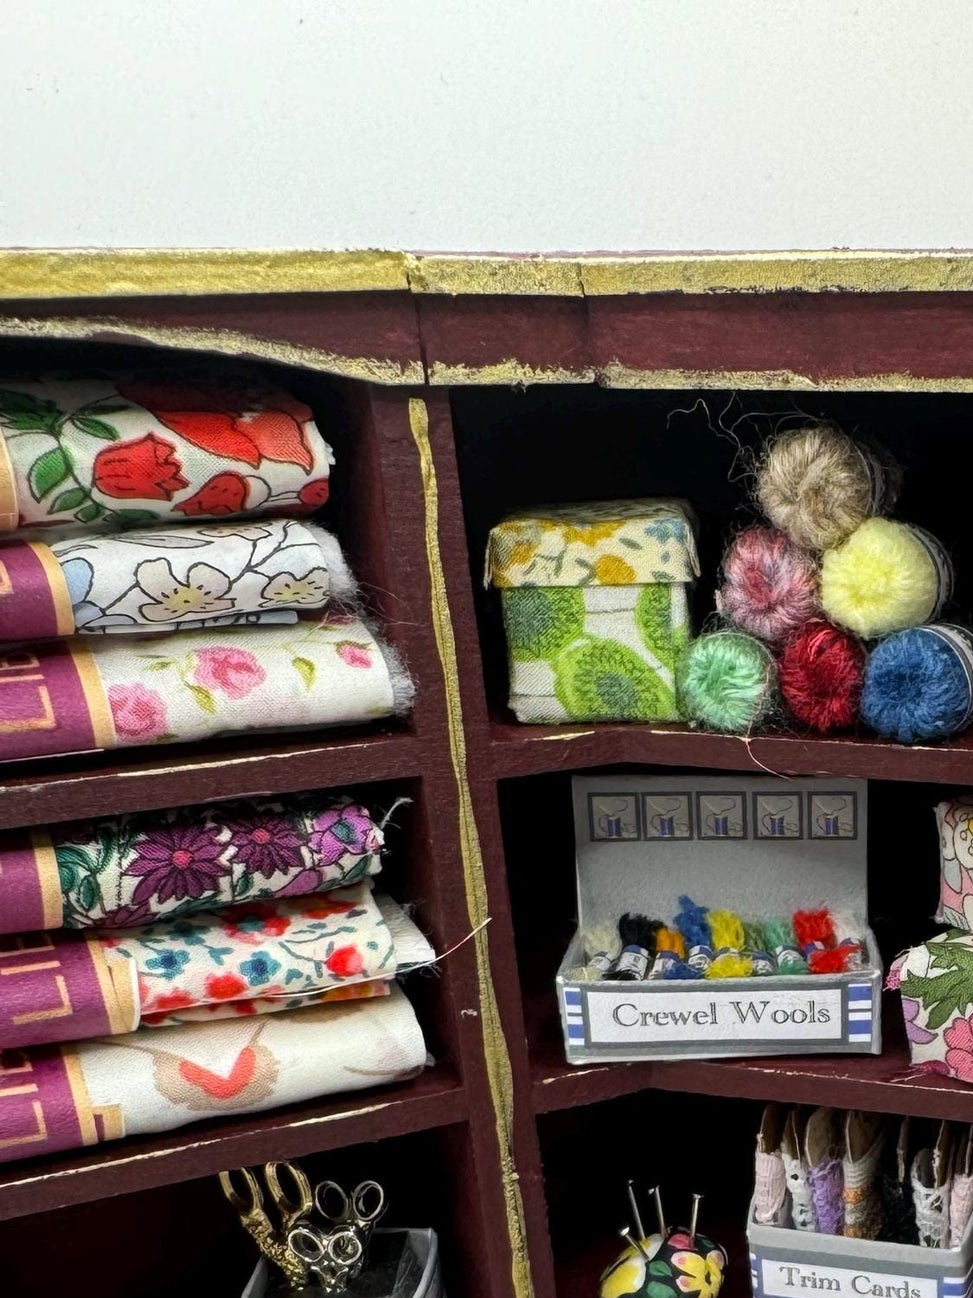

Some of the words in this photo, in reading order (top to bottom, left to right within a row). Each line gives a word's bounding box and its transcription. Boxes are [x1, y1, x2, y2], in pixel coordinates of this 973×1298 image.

[612, 1002, 717, 1027] Crewel
[729, 1000, 831, 1025] Wools
[779, 1266, 841, 1292] Trim
